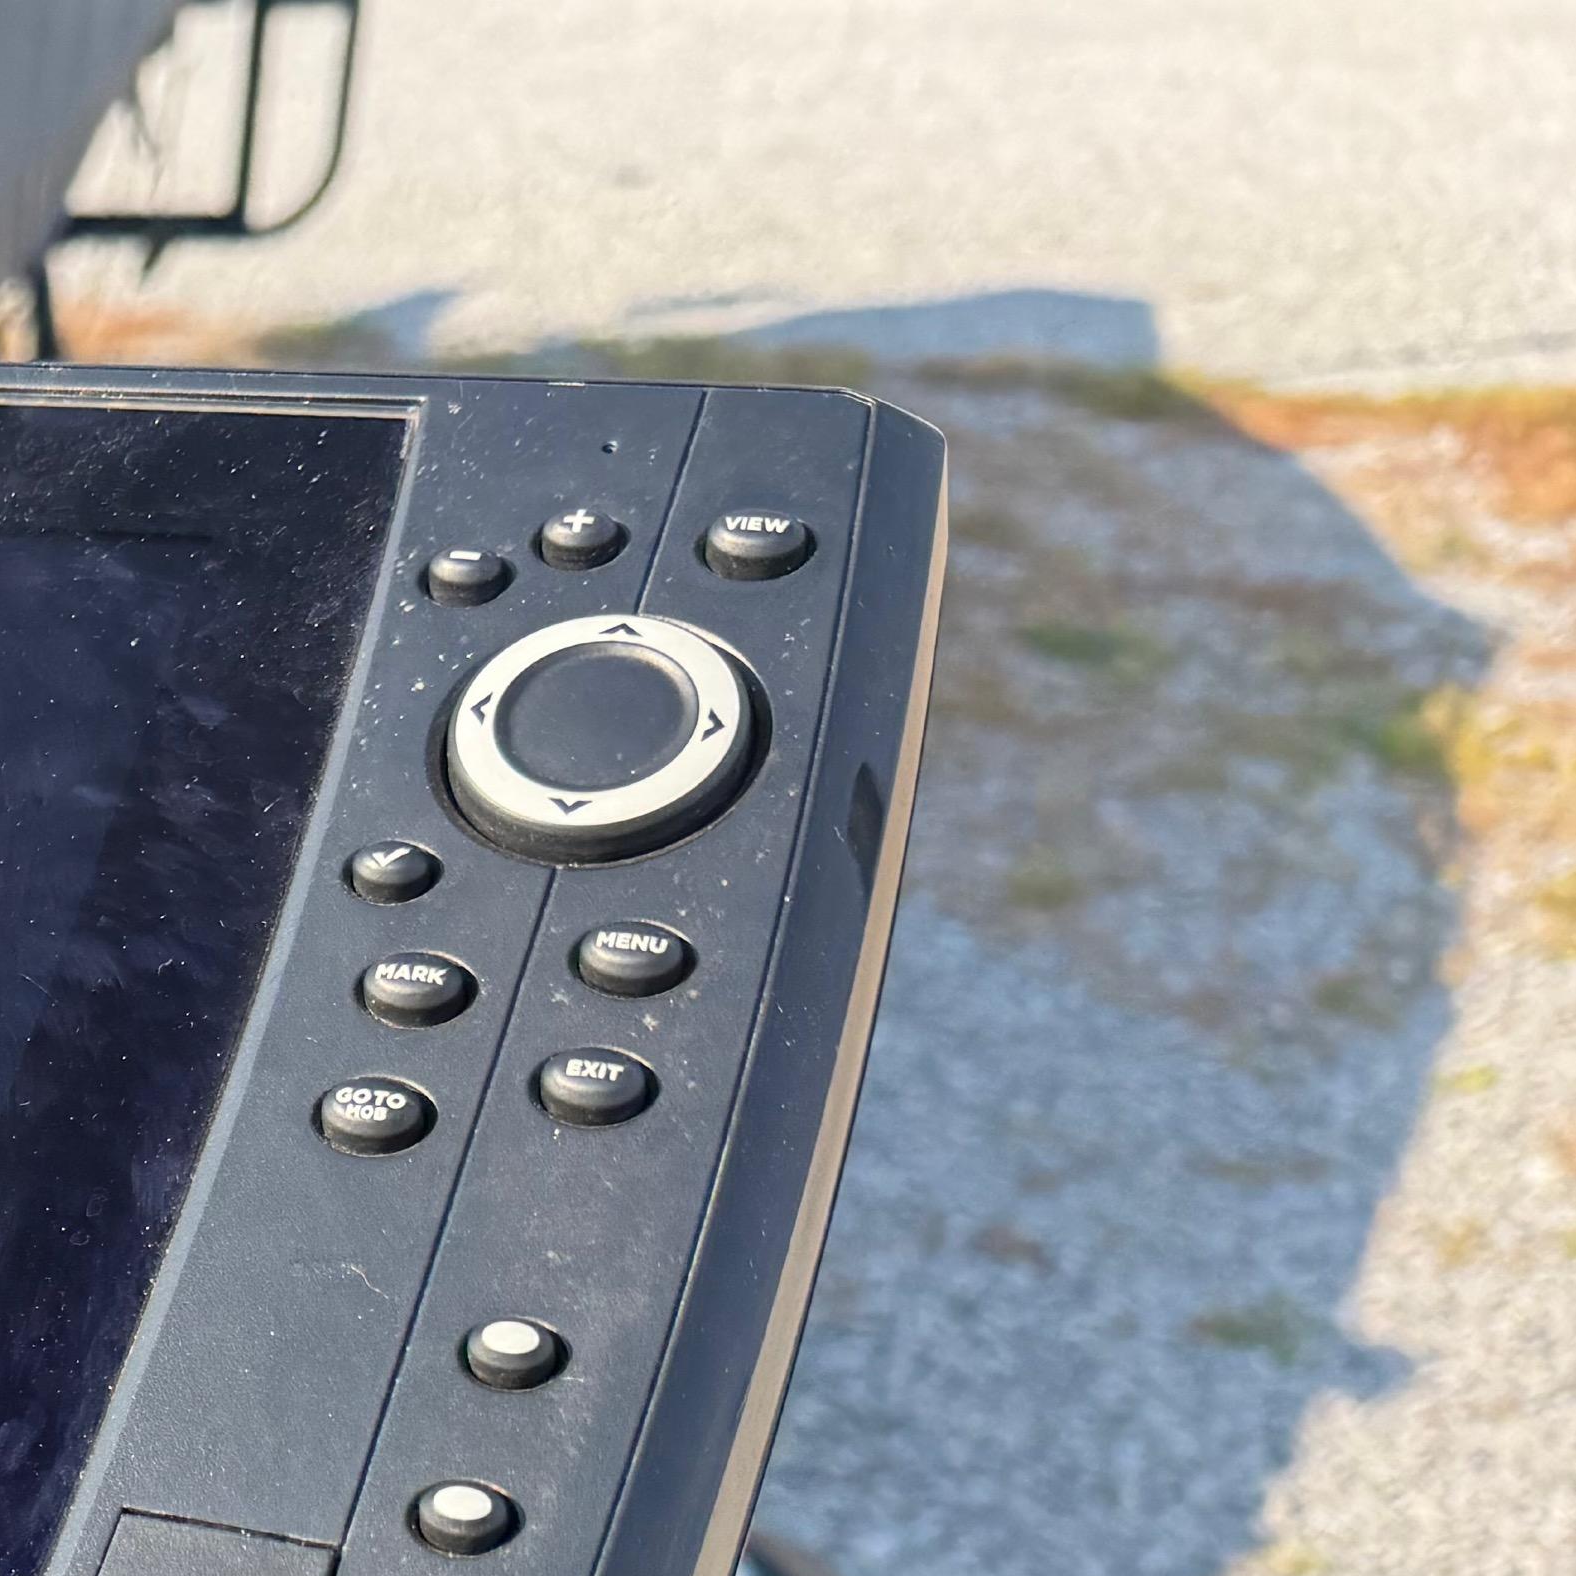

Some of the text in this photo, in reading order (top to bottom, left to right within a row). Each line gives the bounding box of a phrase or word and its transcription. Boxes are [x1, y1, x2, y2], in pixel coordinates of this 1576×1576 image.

[724, 516, 791, 534] VIEW
[596, 930, 669, 954] MENU
[374, 963, 446, 986] MARK
[565, 1058, 625, 1082] EXIT
[344, 1103, 388, 1122] MOB
